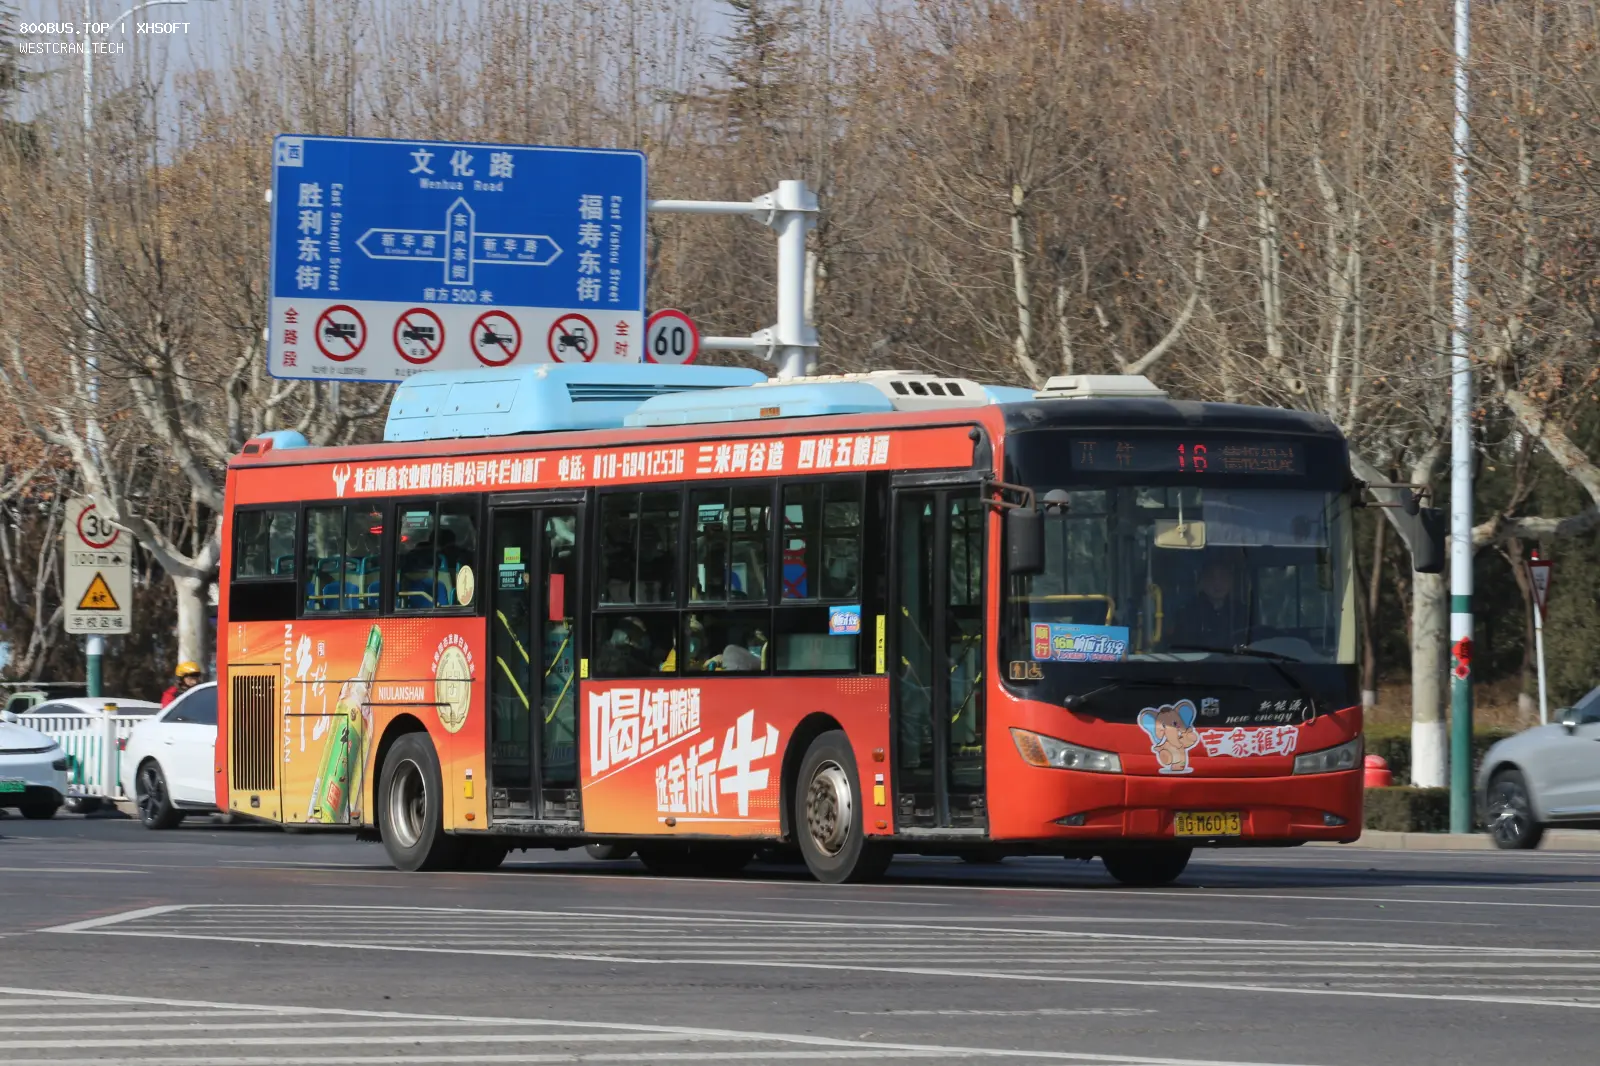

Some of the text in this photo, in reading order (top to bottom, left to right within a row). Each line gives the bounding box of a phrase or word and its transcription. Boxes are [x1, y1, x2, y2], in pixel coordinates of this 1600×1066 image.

[409, 148, 515, 178] 文化路
[330, 183, 344, 207] East
[420, 178, 504, 192] Wenhua Road
[295, 182, 323, 291] 胜利东街
[381, 233, 436, 249] 新华路
[452, 213, 468, 279] 东风东街
[483, 238, 538, 254] 新华路
[577, 194, 603, 302] 福寿东街
[655, 326, 686, 356] 60
[592, 448, 685, 480] 010-69412536
[696, 441, 784, 473] 三米两谷造
[798, 435, 890, 469] 四优五粮酒
[1177, 444, 1208, 473] 16
[354, 457, 546, 493] 北京顺鑫农业股份有限公司牛栏山酒厂
[86, 514, 113, 537] 30
[283, 624, 293, 763] NIULANSHAN
[378, 686, 425, 701] NIULANSHAN
[588, 688, 701, 777] 喝纯粮酒
[1202, 728, 1296, 755] 吉象潍坊
[655, 709, 780, 817] 选金标牛
